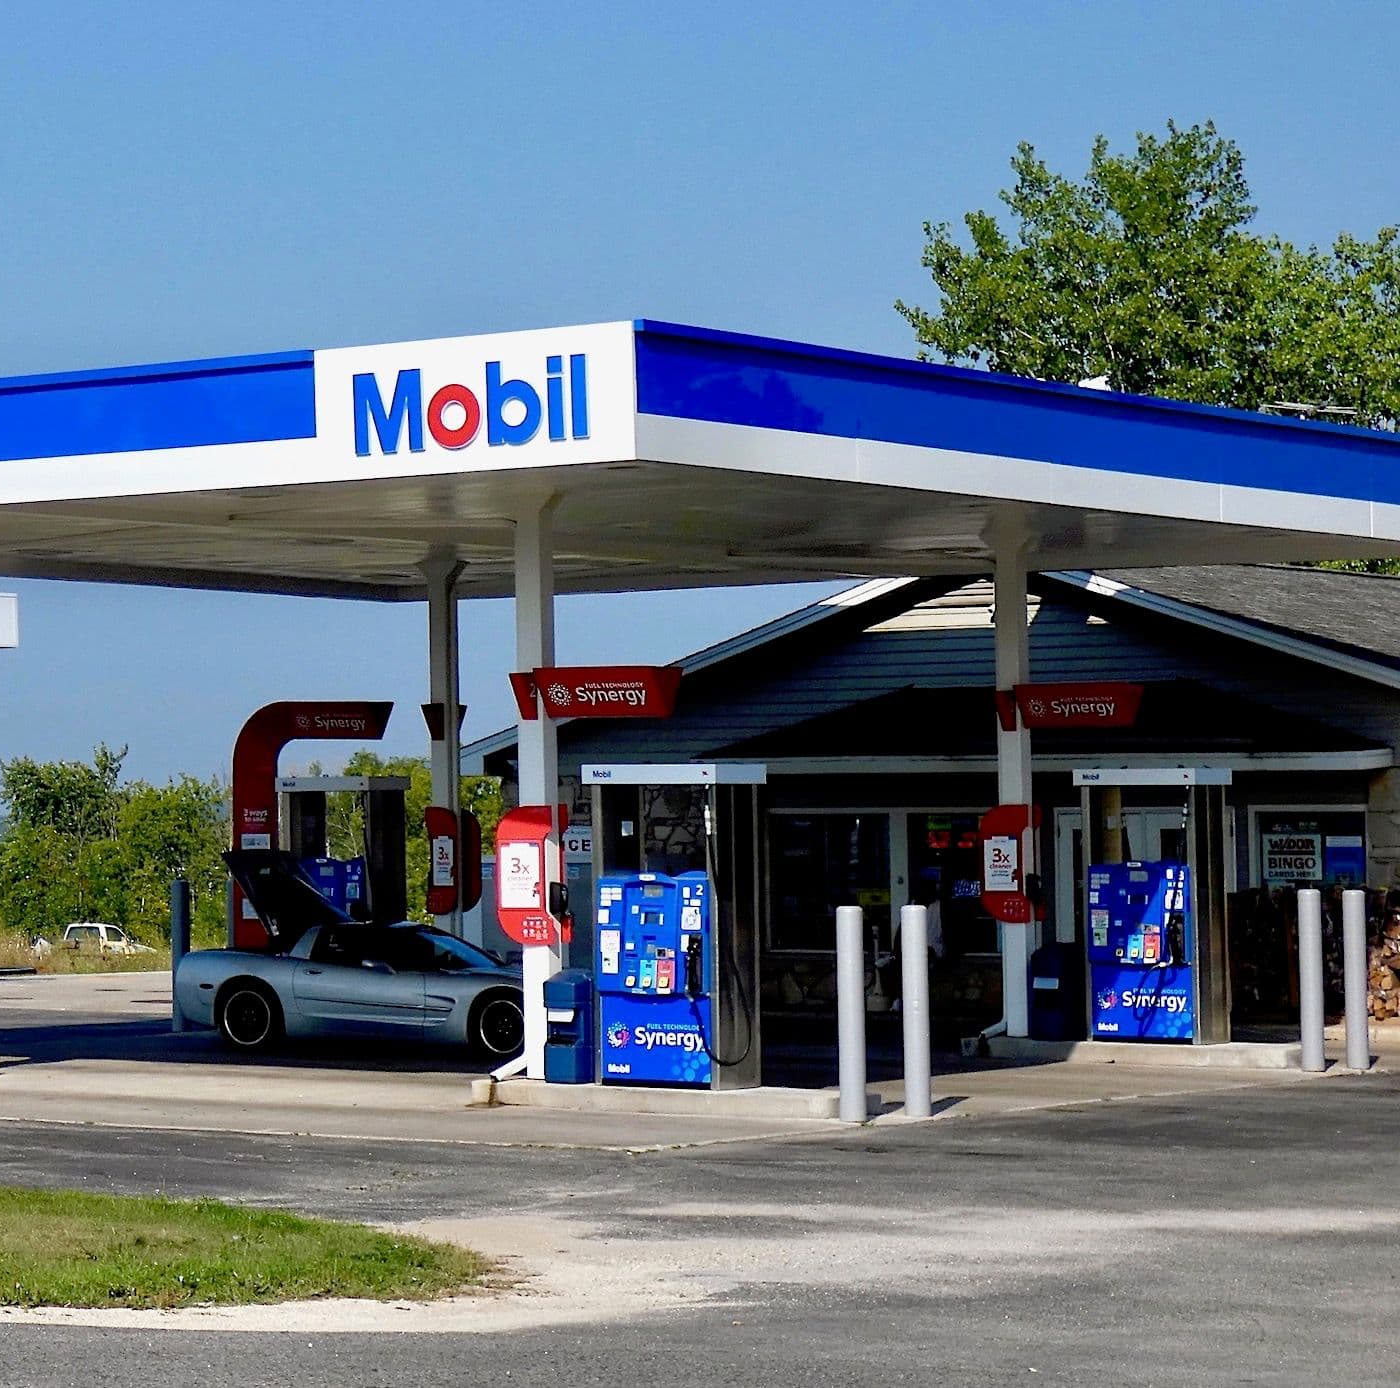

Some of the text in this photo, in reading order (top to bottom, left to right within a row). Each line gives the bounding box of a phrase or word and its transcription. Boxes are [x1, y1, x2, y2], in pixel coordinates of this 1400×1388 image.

[352, 353, 590, 457] Mobil
[575, 687, 646, 706] Synergy
[1050, 700, 1115, 718] Synergy
[314, 716, 366, 731] Synergy
[592, 770, 612, 778] Mobil
[1082, 773, 1100, 781] Mobil
[438, 846, 449, 860] 3x
[992, 848, 1010, 863] 3x
[511, 857, 531, 875] 3x
[1268, 857, 1317, 869] BINGO
[695, 884, 704, 896] 2
[1098, 1022, 1119, 1031] Mobil
[634, 1026, 704, 1052] Synergy
[608, 1063, 631, 1073] Mobil
